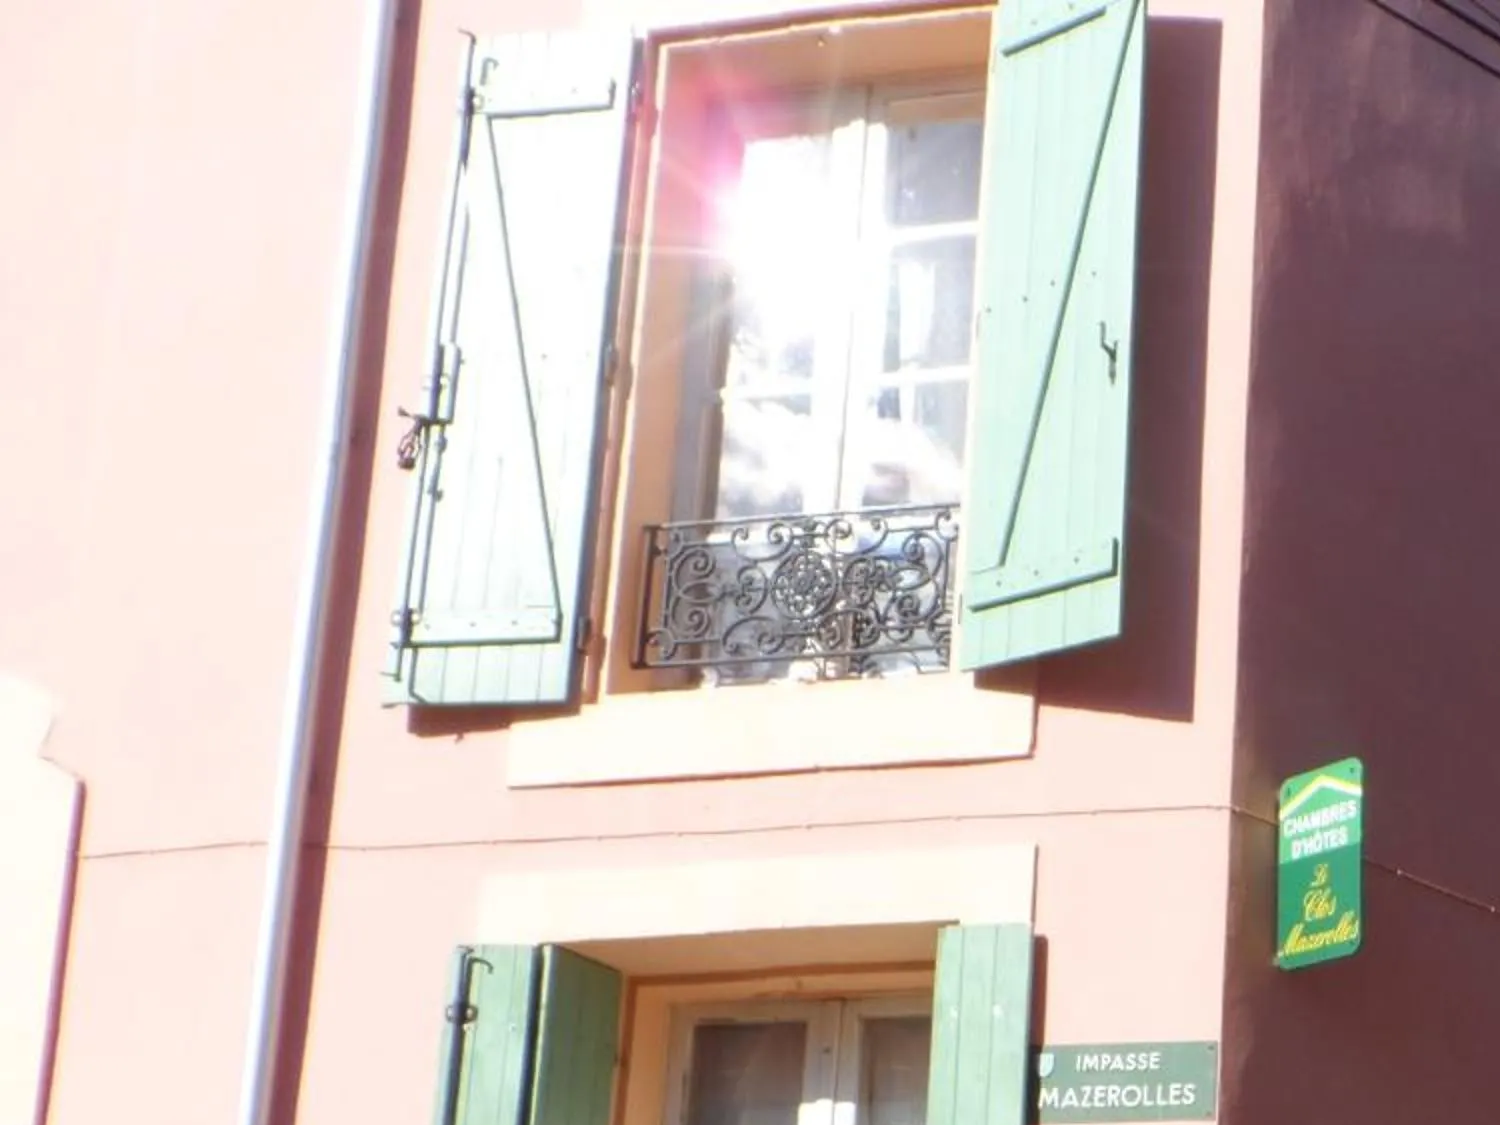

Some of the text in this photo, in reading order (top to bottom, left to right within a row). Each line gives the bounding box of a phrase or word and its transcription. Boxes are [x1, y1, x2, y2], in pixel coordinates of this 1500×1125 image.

[1283, 799, 1358, 837] CHAMBRES
[1075, 1052, 1162, 1072] IMPASSE
[1038, 1083, 1197, 1109] MAZEROLLES
